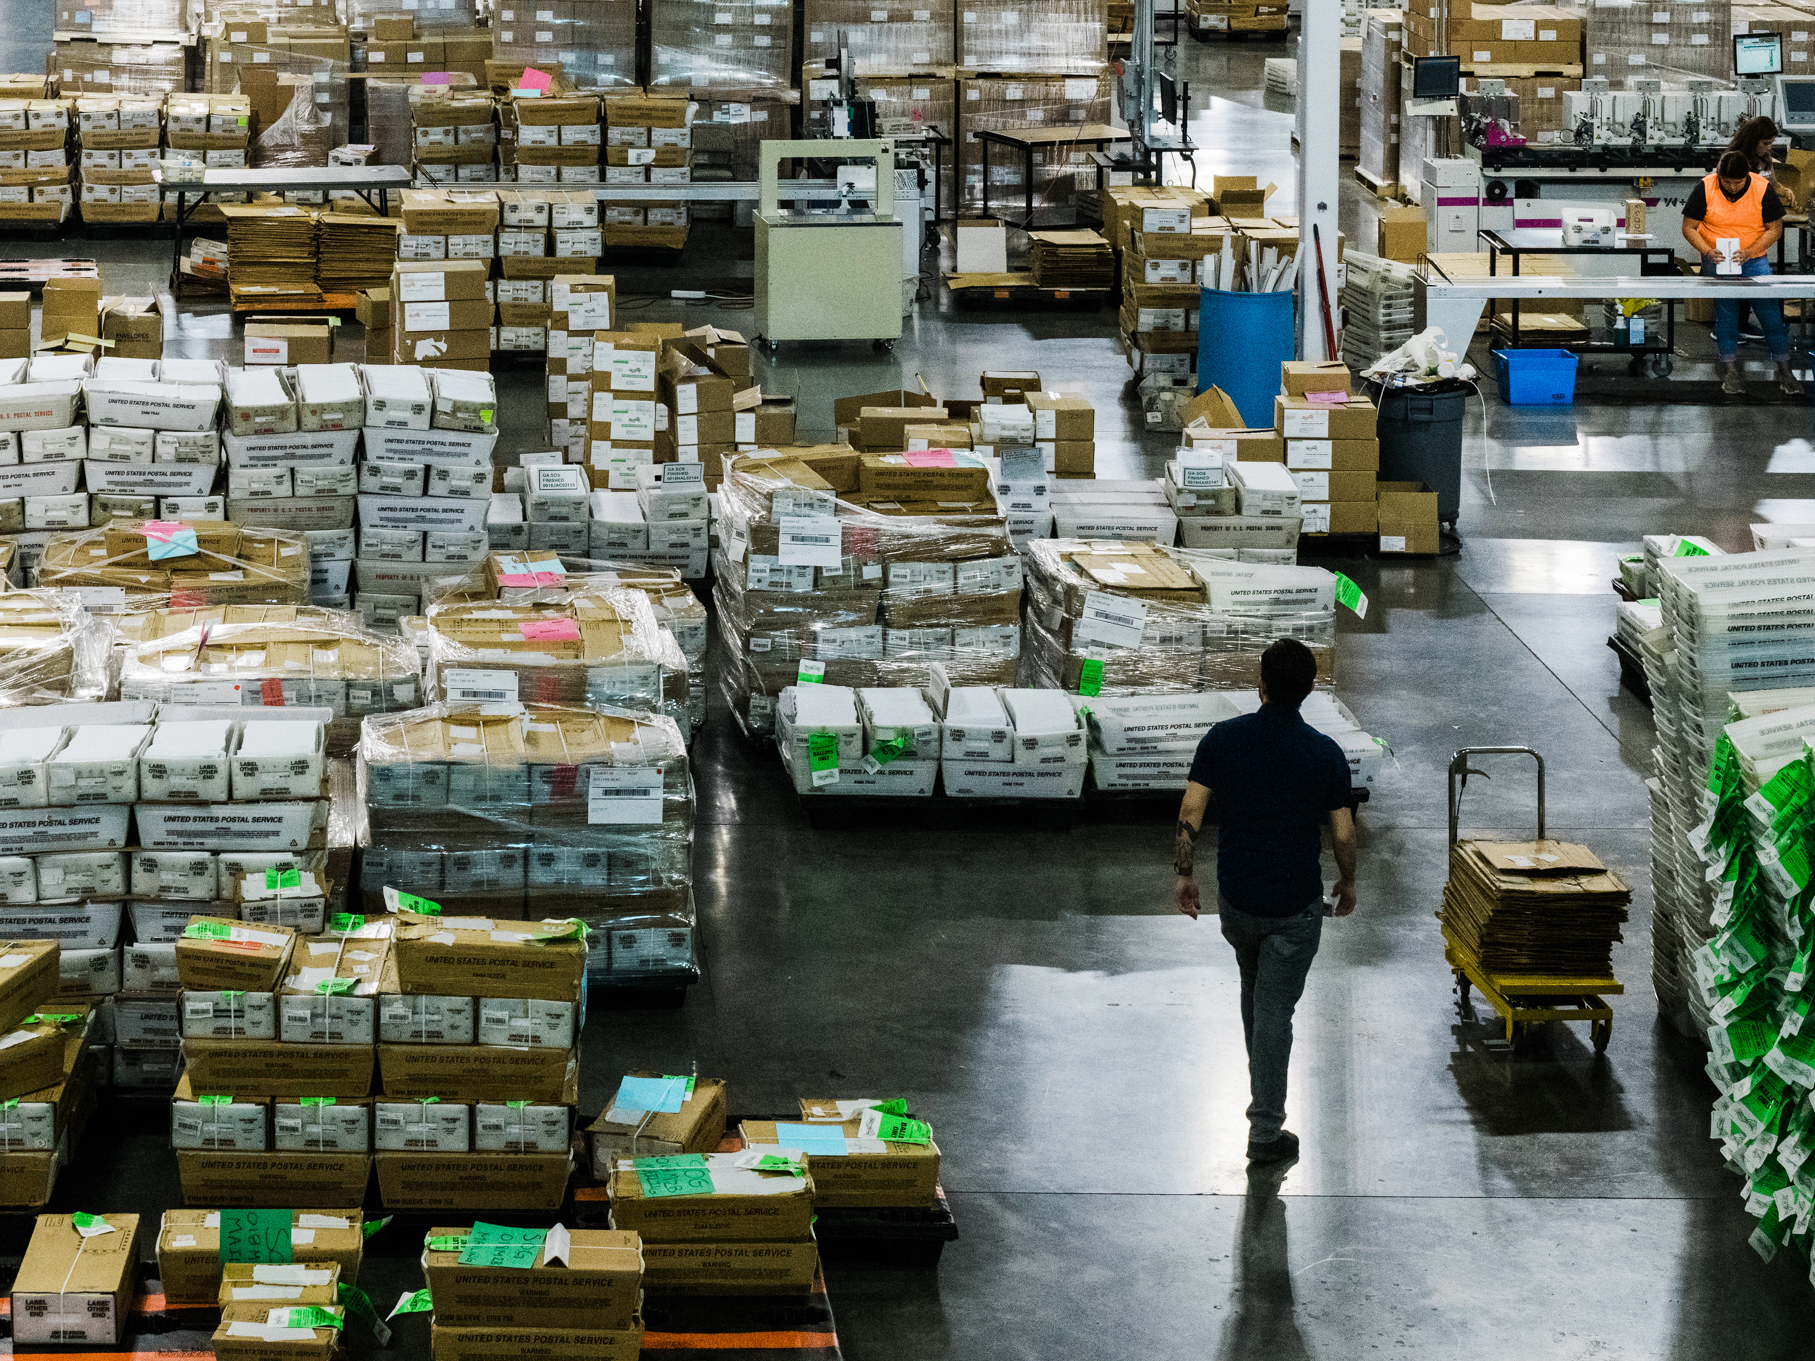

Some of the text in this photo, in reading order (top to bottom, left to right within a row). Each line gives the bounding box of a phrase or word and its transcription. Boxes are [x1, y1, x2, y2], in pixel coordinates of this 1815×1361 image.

[456, 958, 484, 966] STATES
[405, 1055, 436, 1064] UNITED
[439, 1056, 471, 1064] STATES
[1759, 1084, 1779, 1107] BALLOTS
[201, 1161, 232, 1170] UNITED
[235, 1162, 267, 1170] STATES
